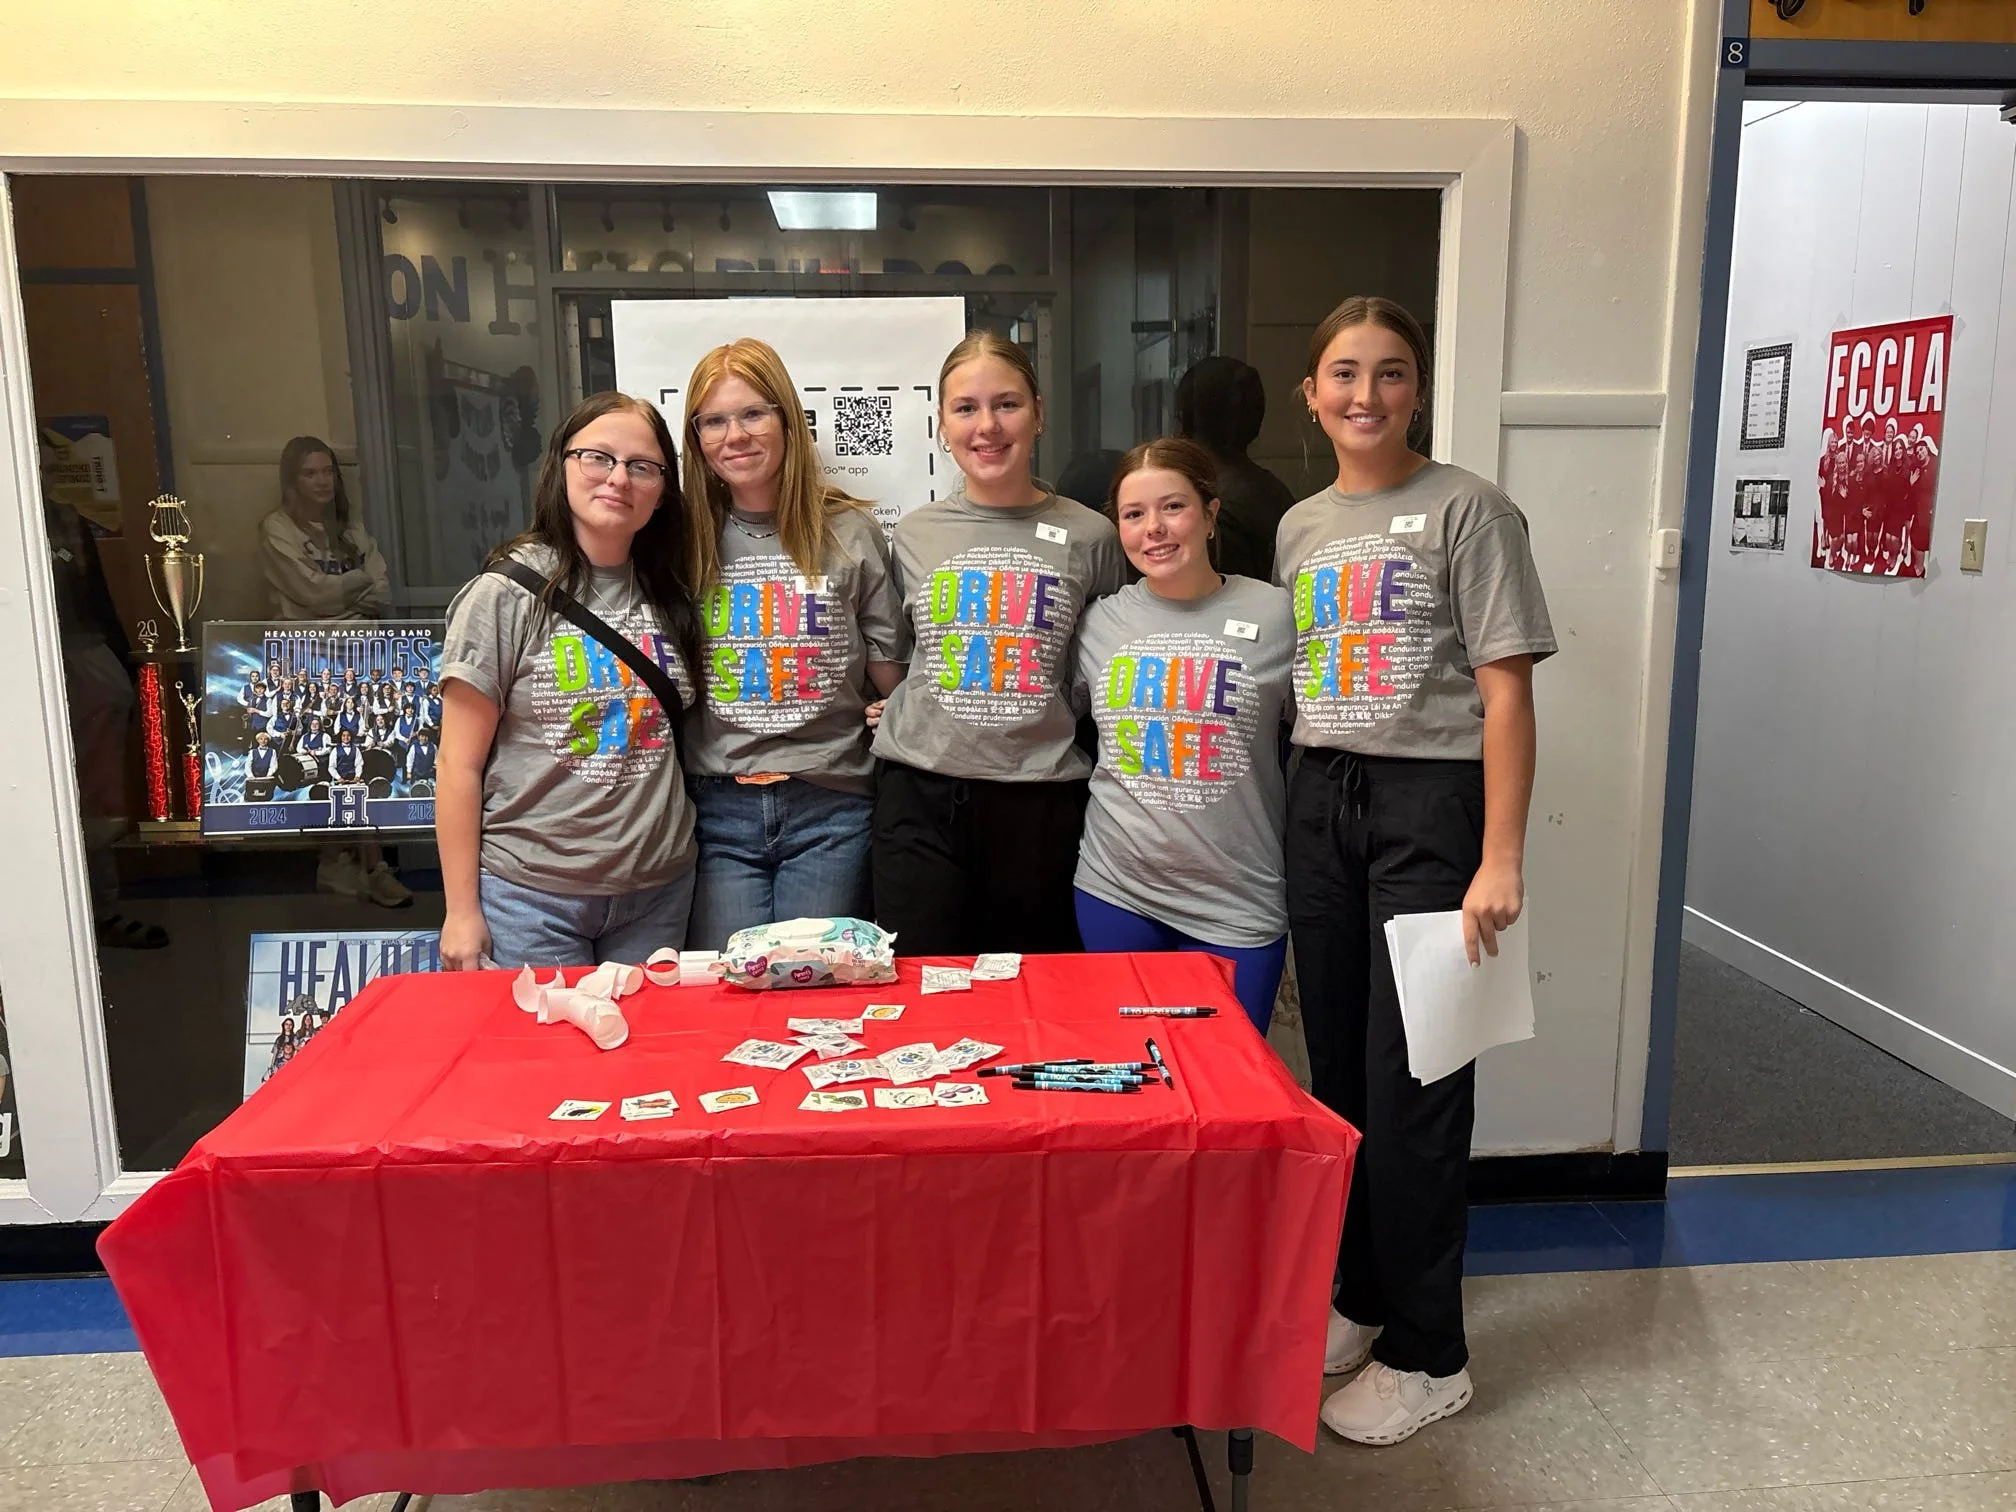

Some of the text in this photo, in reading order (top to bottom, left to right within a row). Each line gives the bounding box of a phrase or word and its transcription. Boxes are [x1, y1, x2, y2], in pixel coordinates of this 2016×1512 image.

[1728, 42, 1743, 64] 8
[1827, 332, 1944, 418] FCCLA
[848, 467, 868, 476] app
[703, 581, 829, 637] DRIVE
[930, 571, 1060, 630] DRIVE
[1294, 560, 1412, 632] DRIVE
[733, 641, 766, 649] precaución
[958, 629, 992, 637] precaución
[1373, 626, 1405, 636] ασφάλεια
[264, 637, 431, 680] BULLDOGS
[710, 647, 822, 702] SAFE
[939, 635, 1043, 693] SAFE
[1305, 633, 1396, 699] SAFE
[987, 699, 1017, 708] segurança
[1107, 656, 1241, 716] DRIVE
[768, 707, 799, 715] segurança
[983, 713, 1022, 721] prudemment
[1134, 714, 1169, 722] precaución
[1117, 719, 1226, 780] SAFE
[250, 808, 286, 824] 2024
[329, 786, 369, 829] H
